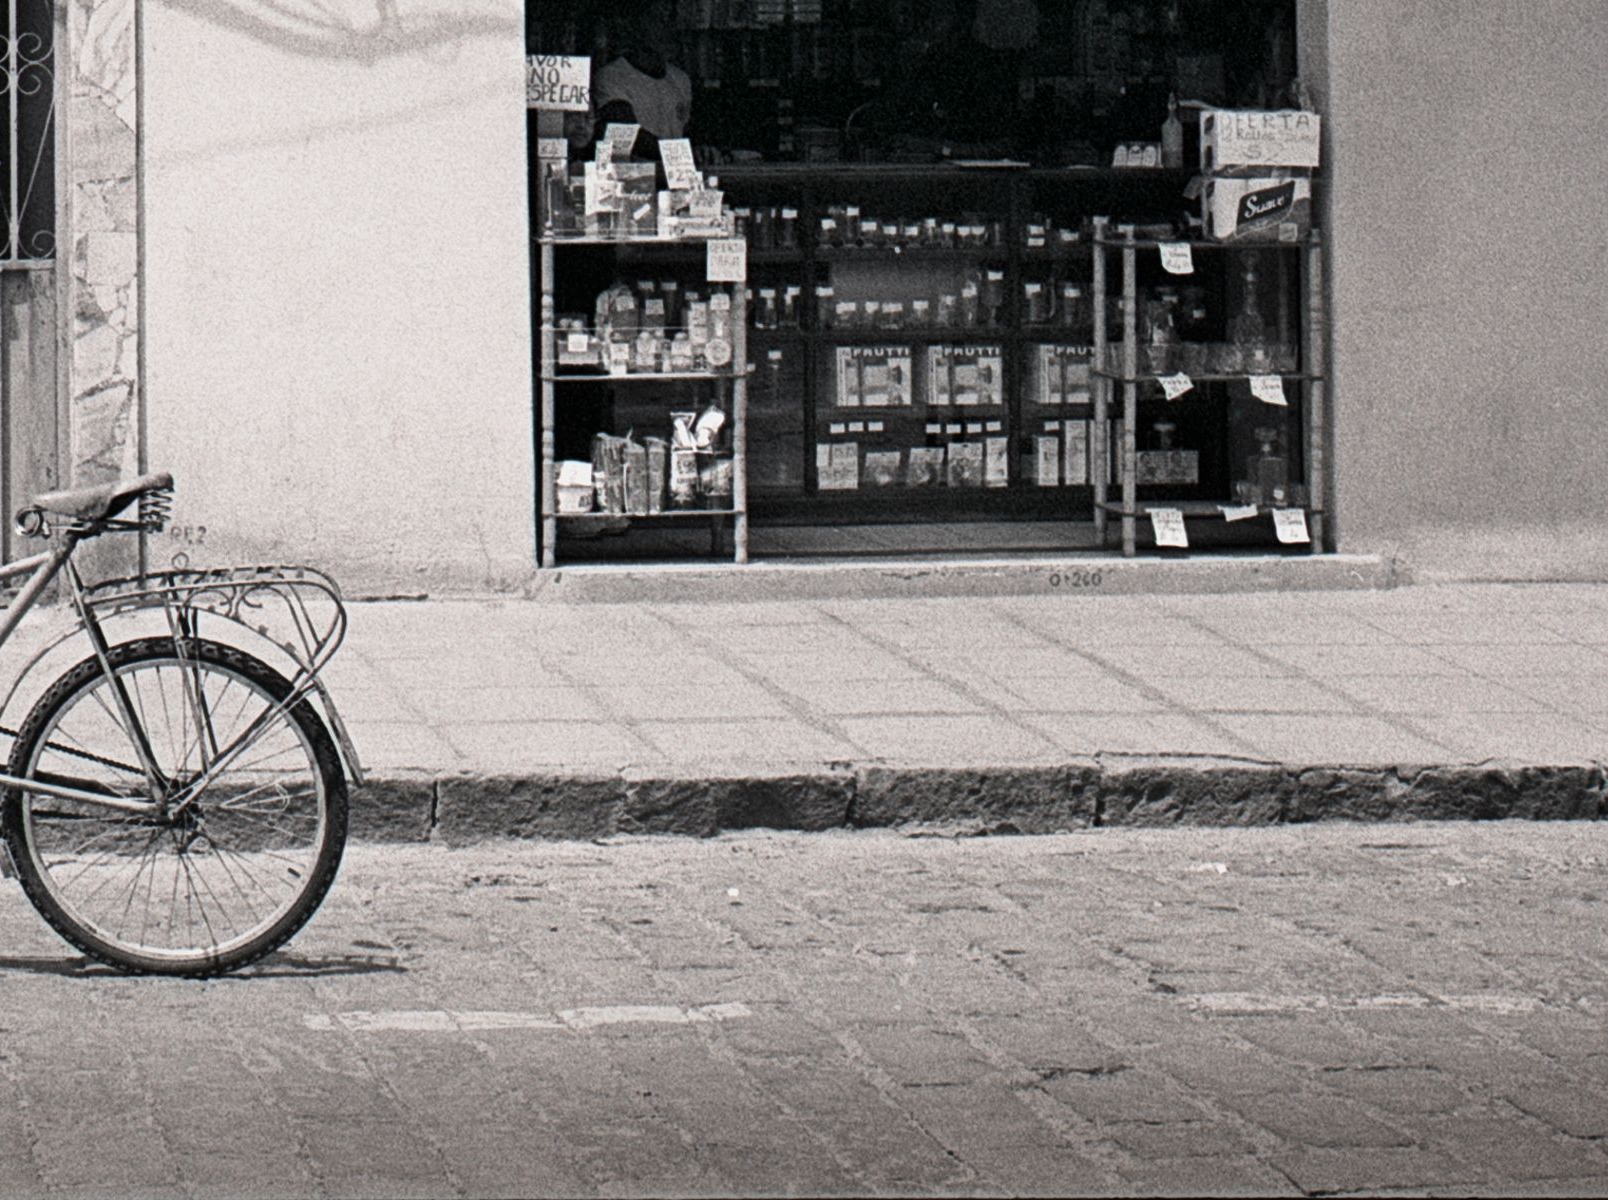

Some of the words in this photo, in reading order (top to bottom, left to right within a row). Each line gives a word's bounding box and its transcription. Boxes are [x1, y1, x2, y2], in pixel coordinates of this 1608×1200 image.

[526, 55, 572, 69] AVOR
[530, 67, 561, 87] NO
[527, 84, 590, 104] SPEGAR
